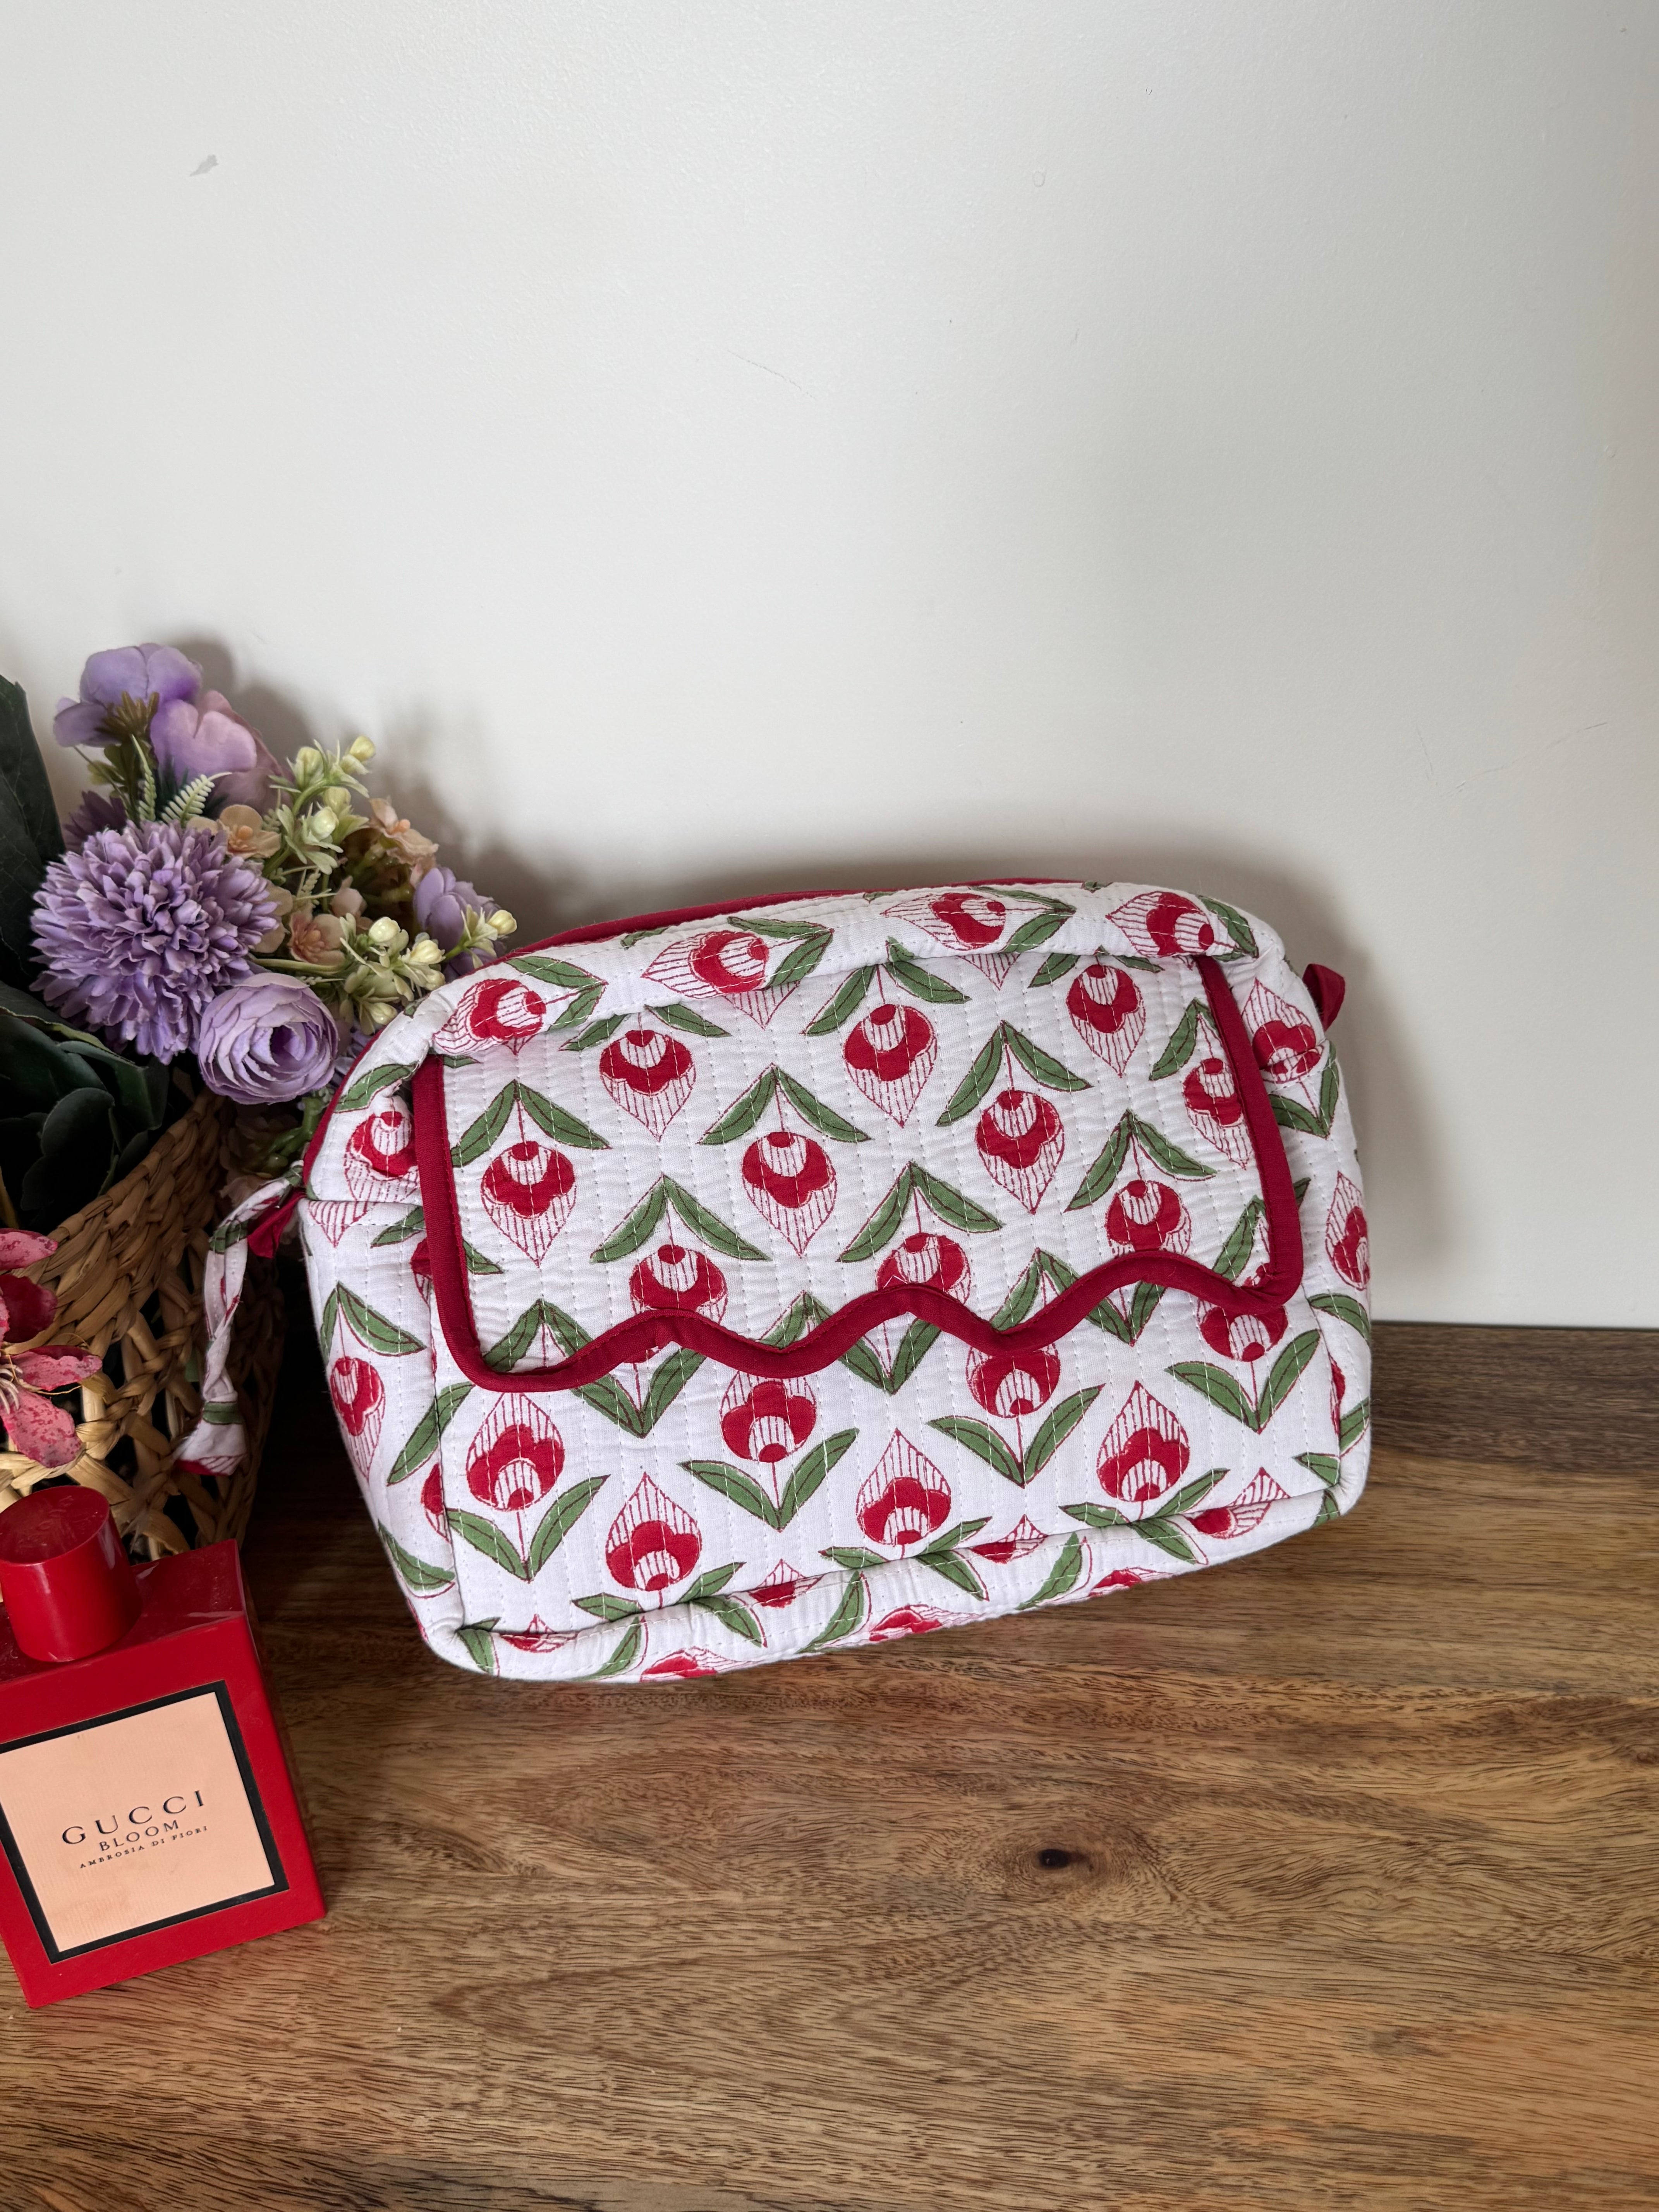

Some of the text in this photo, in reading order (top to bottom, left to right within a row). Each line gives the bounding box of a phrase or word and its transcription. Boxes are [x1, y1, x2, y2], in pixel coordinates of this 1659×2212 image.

[62, 1790, 204, 1844] GUCCI
[99, 1820, 179, 1851] BLOOM
[80, 1826, 208, 1869] AMBROSIA DI FIORI
